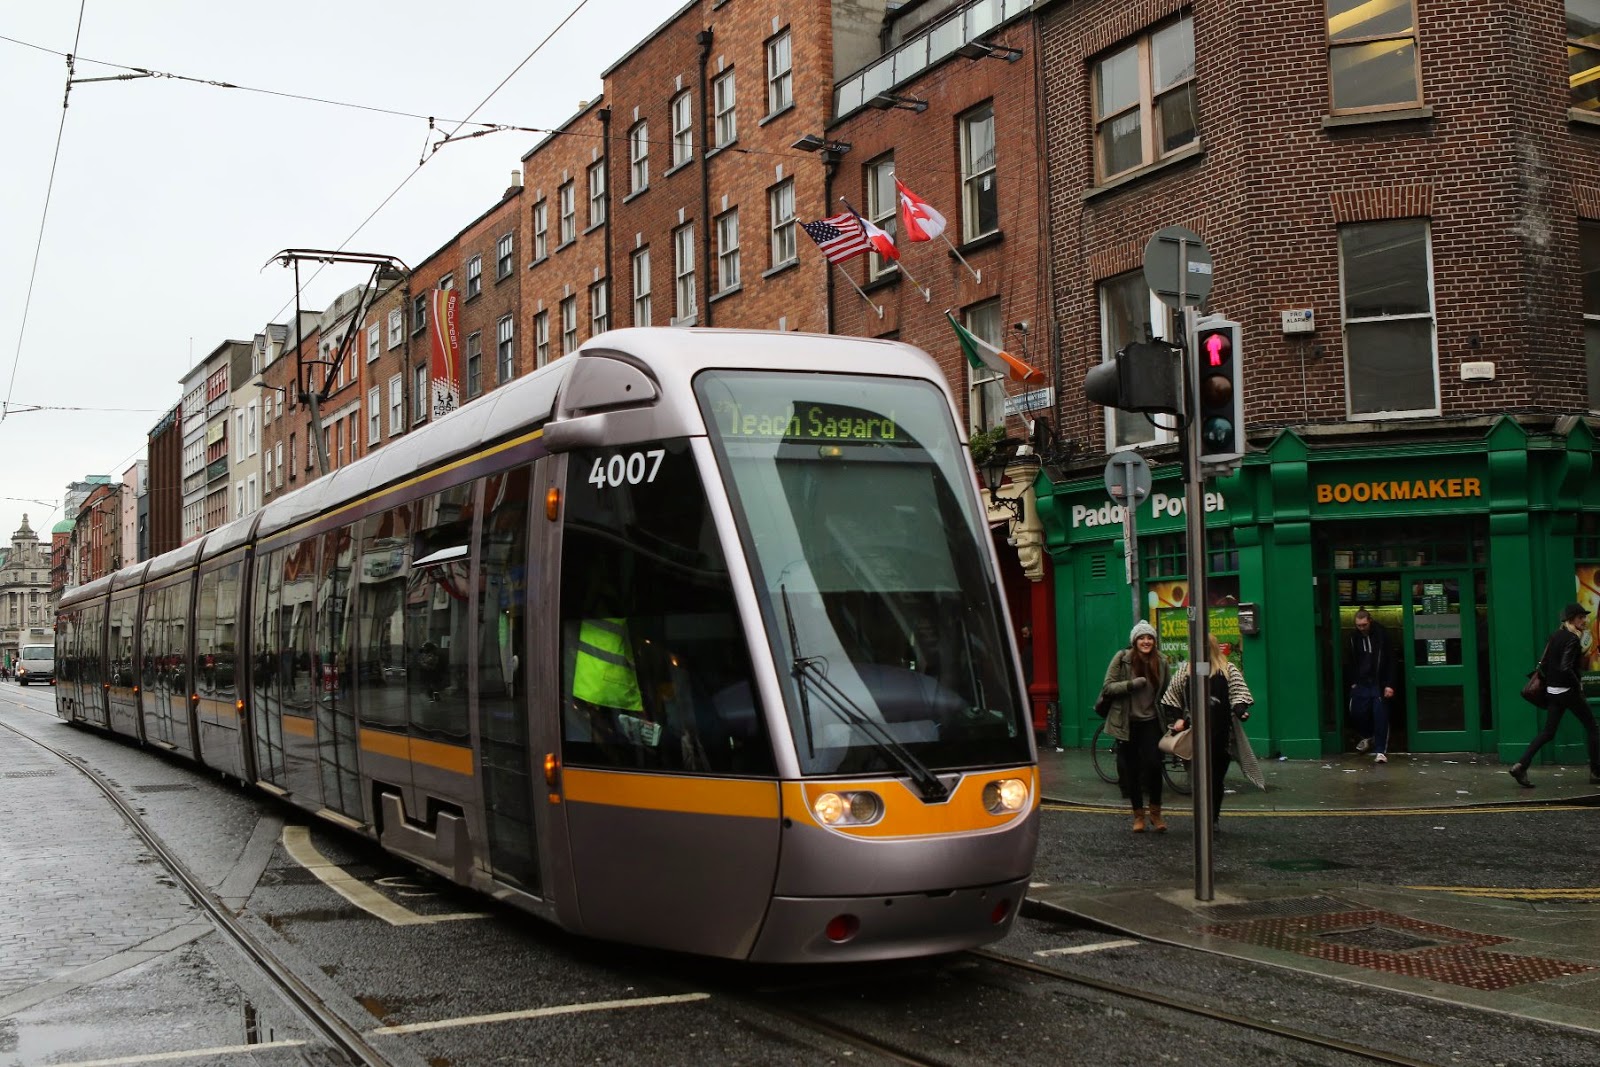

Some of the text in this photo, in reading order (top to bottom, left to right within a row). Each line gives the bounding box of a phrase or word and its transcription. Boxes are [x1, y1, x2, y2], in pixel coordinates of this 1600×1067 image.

[447, 296, 458, 349] epicurean
[729, 402, 896, 439] Teach Sagard
[588, 449, 666, 489] 4007
[1316, 477, 1482, 504] BOOKMAKER
[1072, 492, 1225, 528] Padd Poer
[1209, 618, 1223, 627] BEST
[1161, 642, 1180, 651] LUCKY
